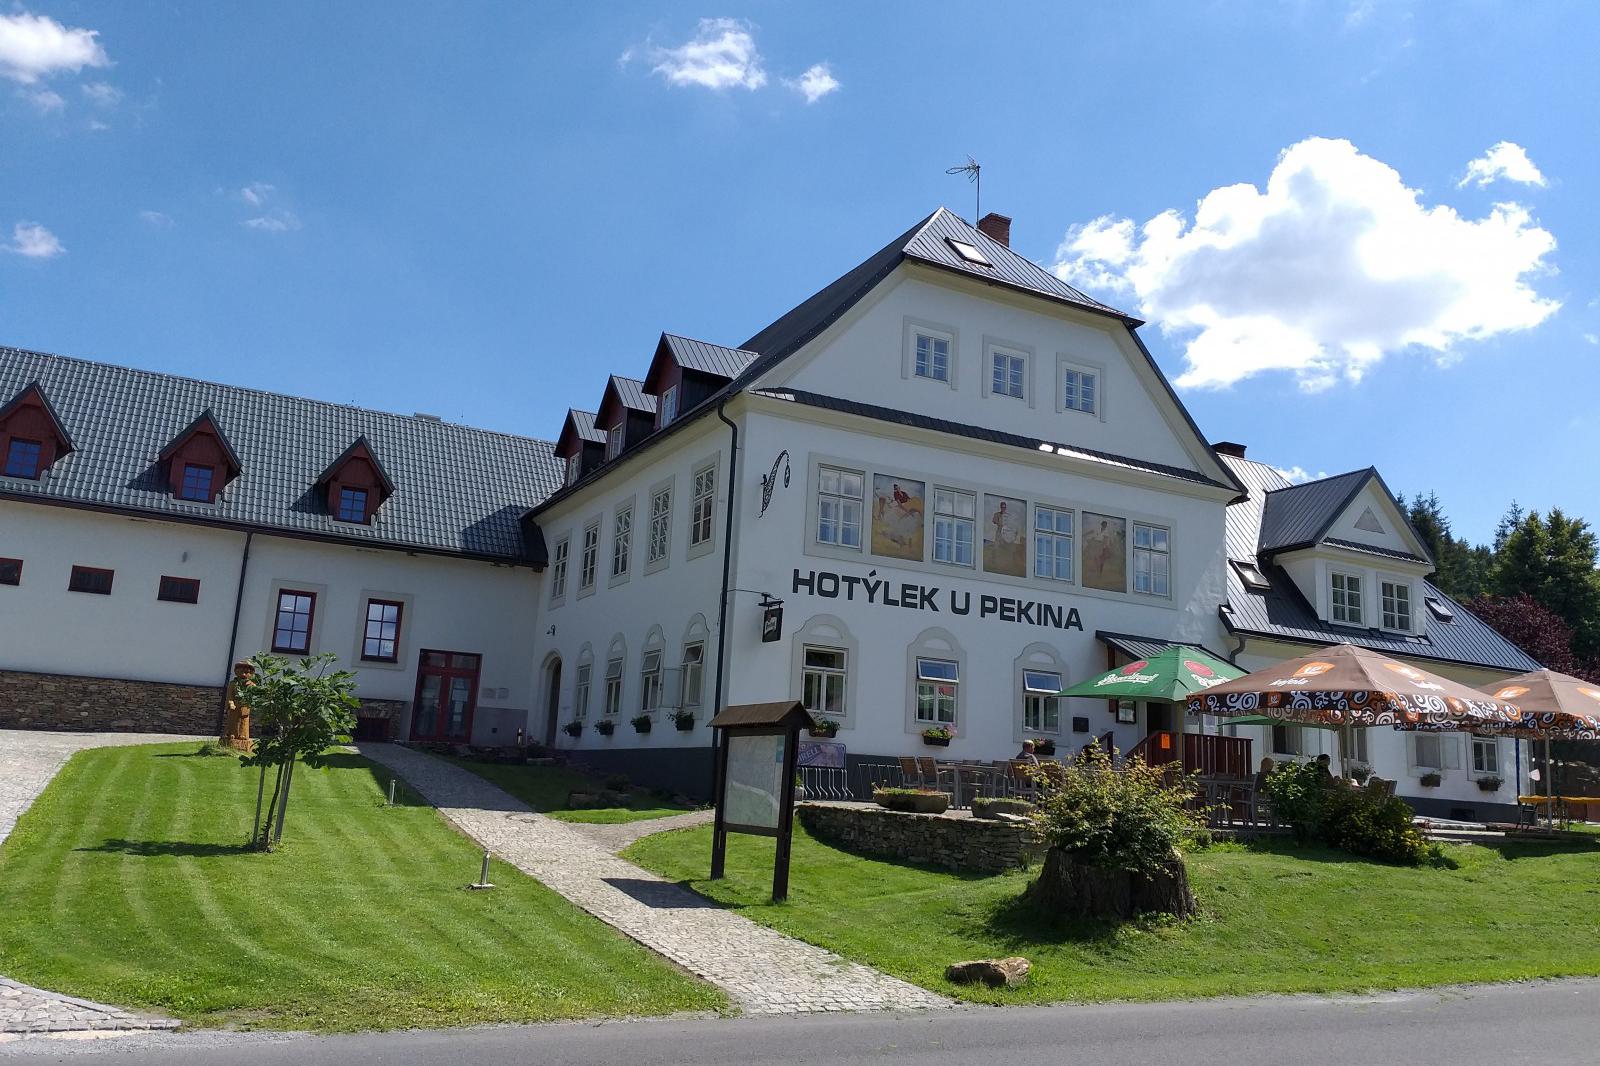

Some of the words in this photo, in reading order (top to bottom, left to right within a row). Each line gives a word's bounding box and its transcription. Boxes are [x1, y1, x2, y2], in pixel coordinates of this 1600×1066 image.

[792, 568, 940, 612] HOTÝLEK
[950, 590, 970, 616] U
[980, 594, 1084, 632] PEKINA
